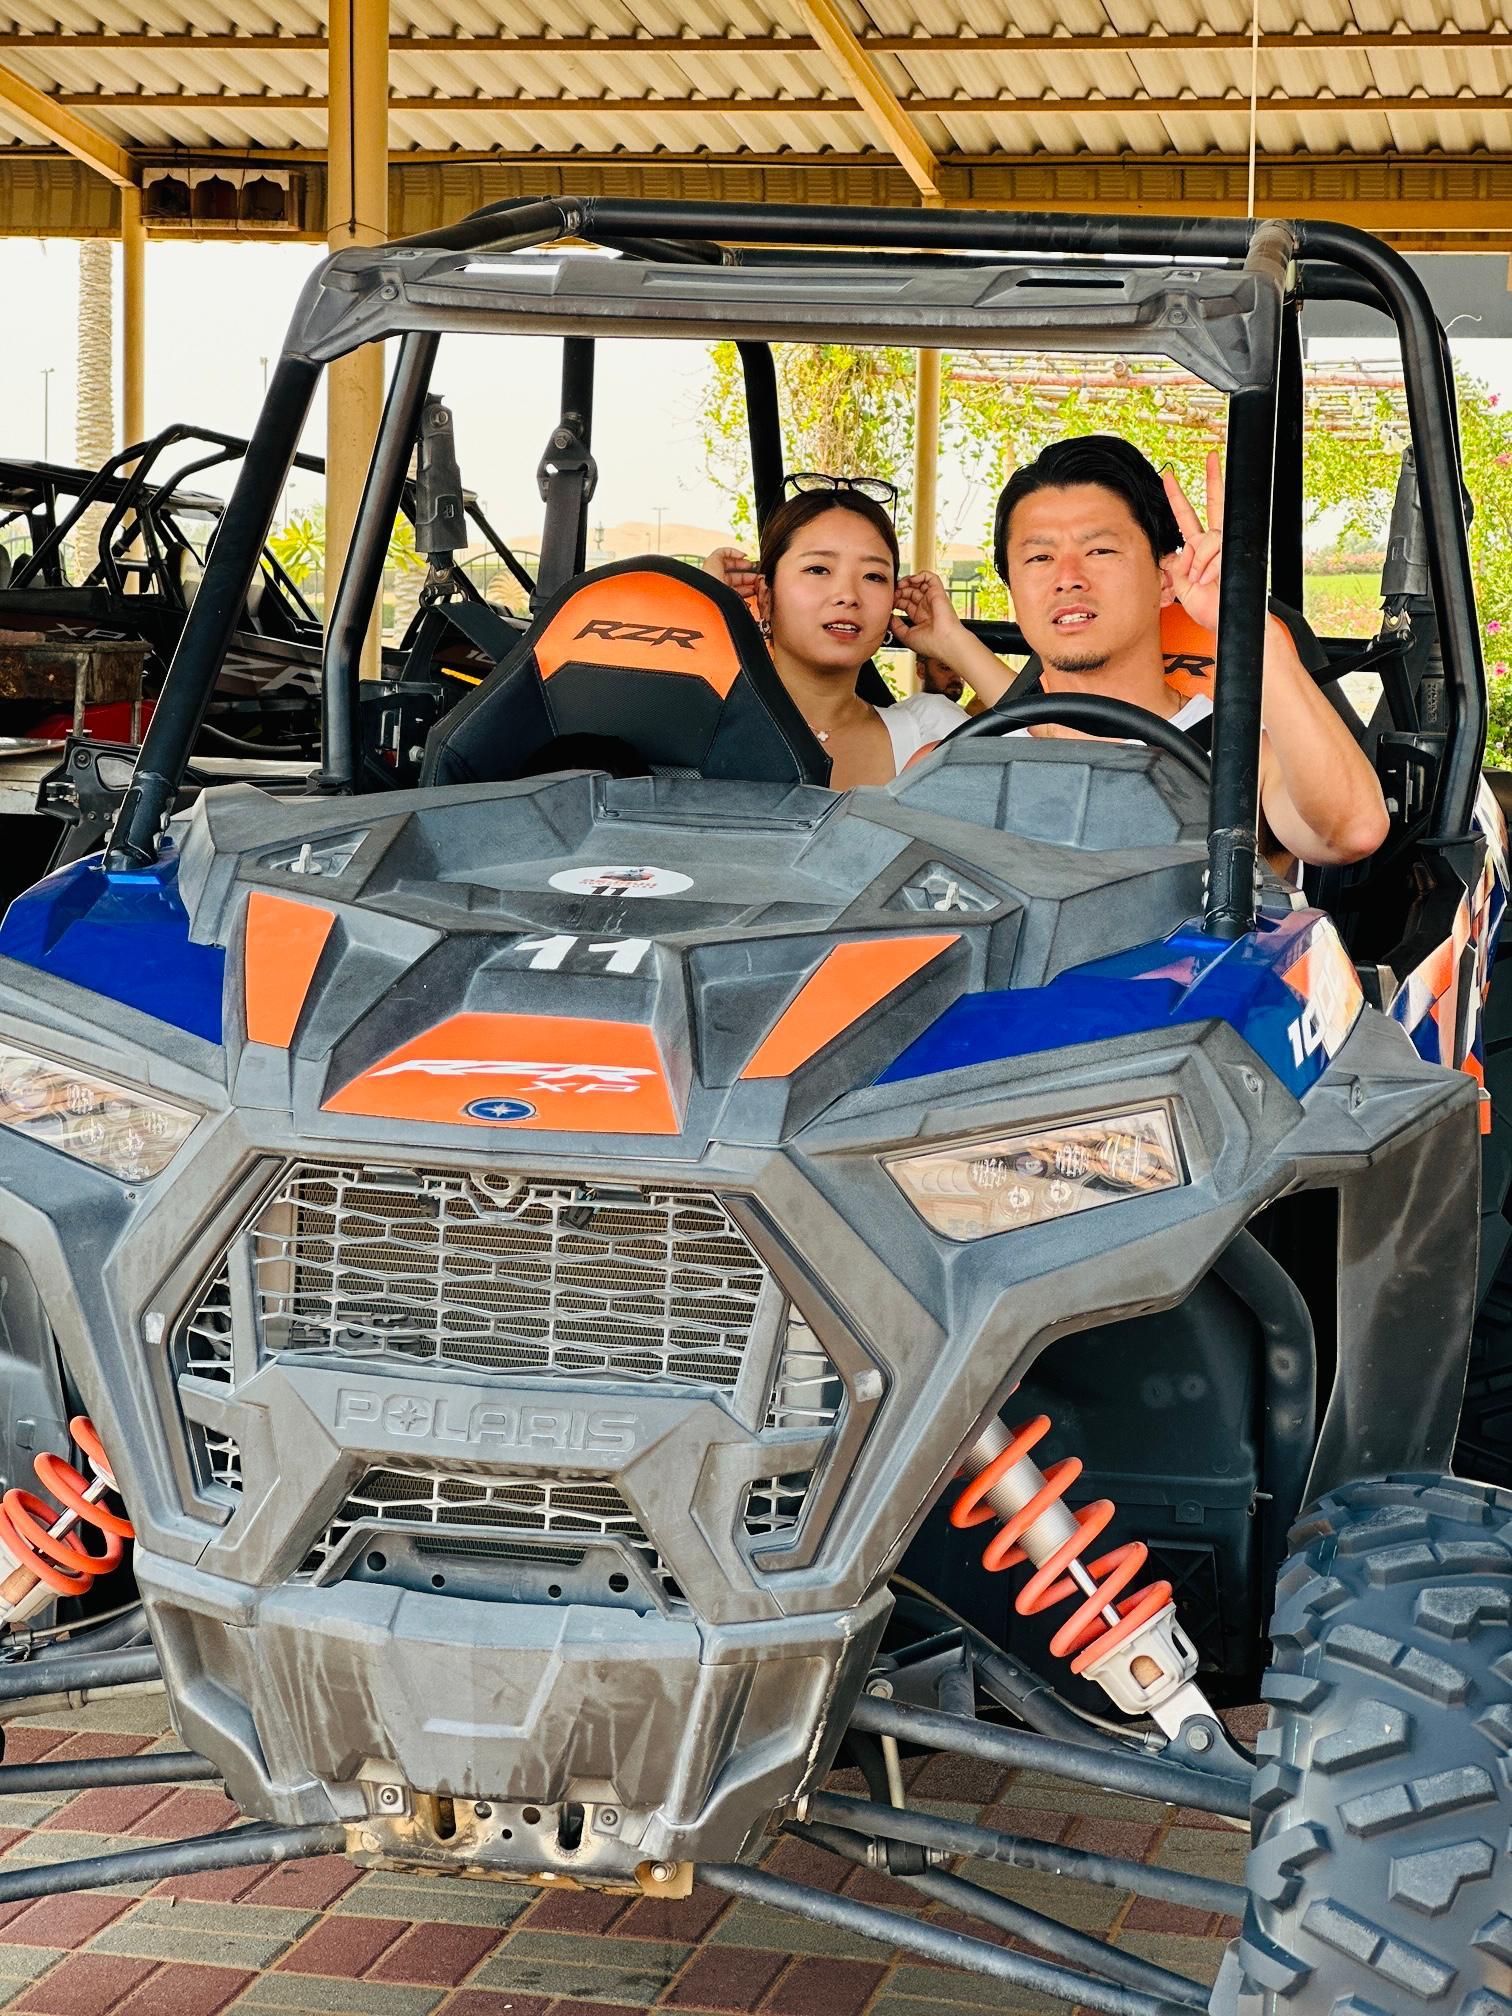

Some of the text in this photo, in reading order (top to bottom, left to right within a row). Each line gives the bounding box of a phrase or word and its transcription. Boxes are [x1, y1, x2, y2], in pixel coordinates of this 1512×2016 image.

[573, 619, 705, 649] RZR
[591, 885, 629, 896] 11
[513, 934, 652, 974] 11
[366, 1058, 658, 1084] RZR
[515, 1080, 641, 1094] XP
[334, 1387, 638, 1452] POLARIS
